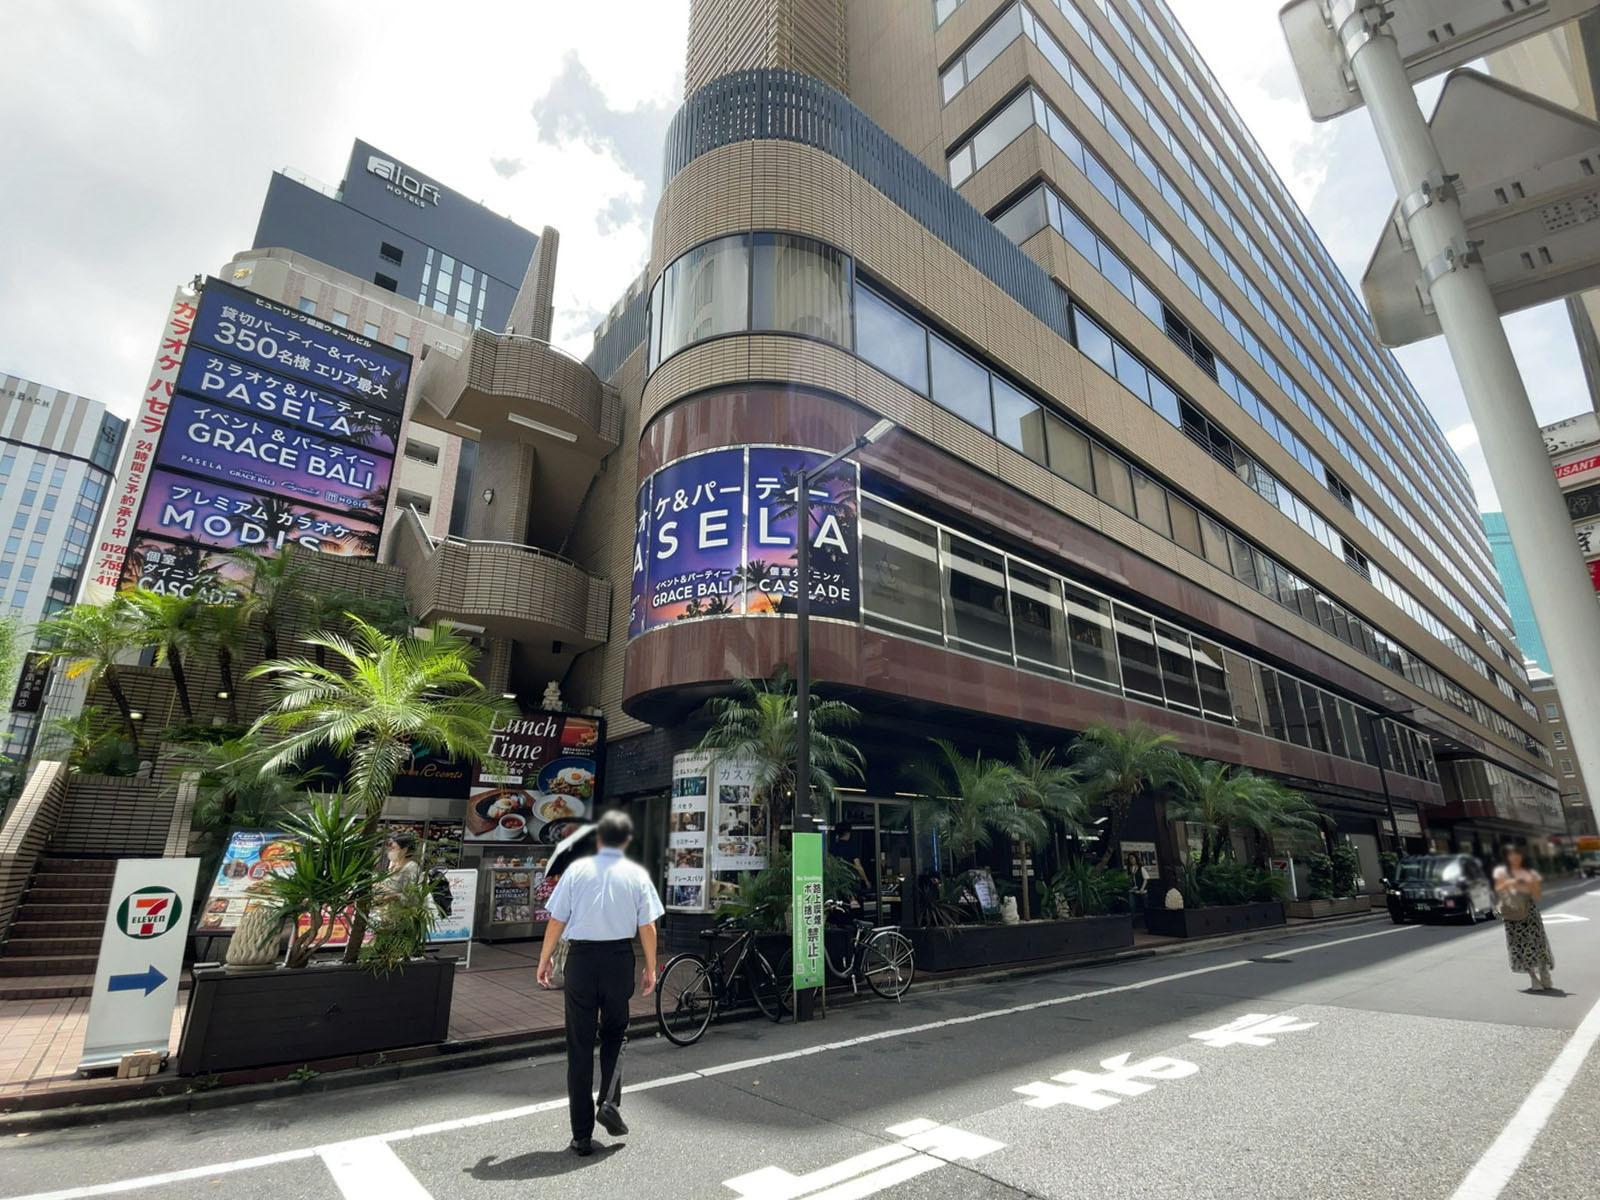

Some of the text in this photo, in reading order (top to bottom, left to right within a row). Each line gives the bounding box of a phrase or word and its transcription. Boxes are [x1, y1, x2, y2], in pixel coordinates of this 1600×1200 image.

[386, 184, 425, 208] HOTELS
[214, 321, 389, 400] 350名様 エリア最大
[201, 372, 352, 436] PASELA
[207, 358, 383, 422] カラオケ&パーティー
[180, 454, 223, 471] PASELA
[188, 423, 372, 491] GRACE BALI
[170, 485, 269, 521] プレミアム
[279, 512, 349, 539] カラオケ
[635, 478, 829, 532] オケ&パーティー
[652, 585, 693, 608] GRACE
[697, 581, 733, 598] BALI
[759, 579, 851, 601] CASADE
[489, 710, 557, 738] Lunch
[487, 734, 543, 760] Time
